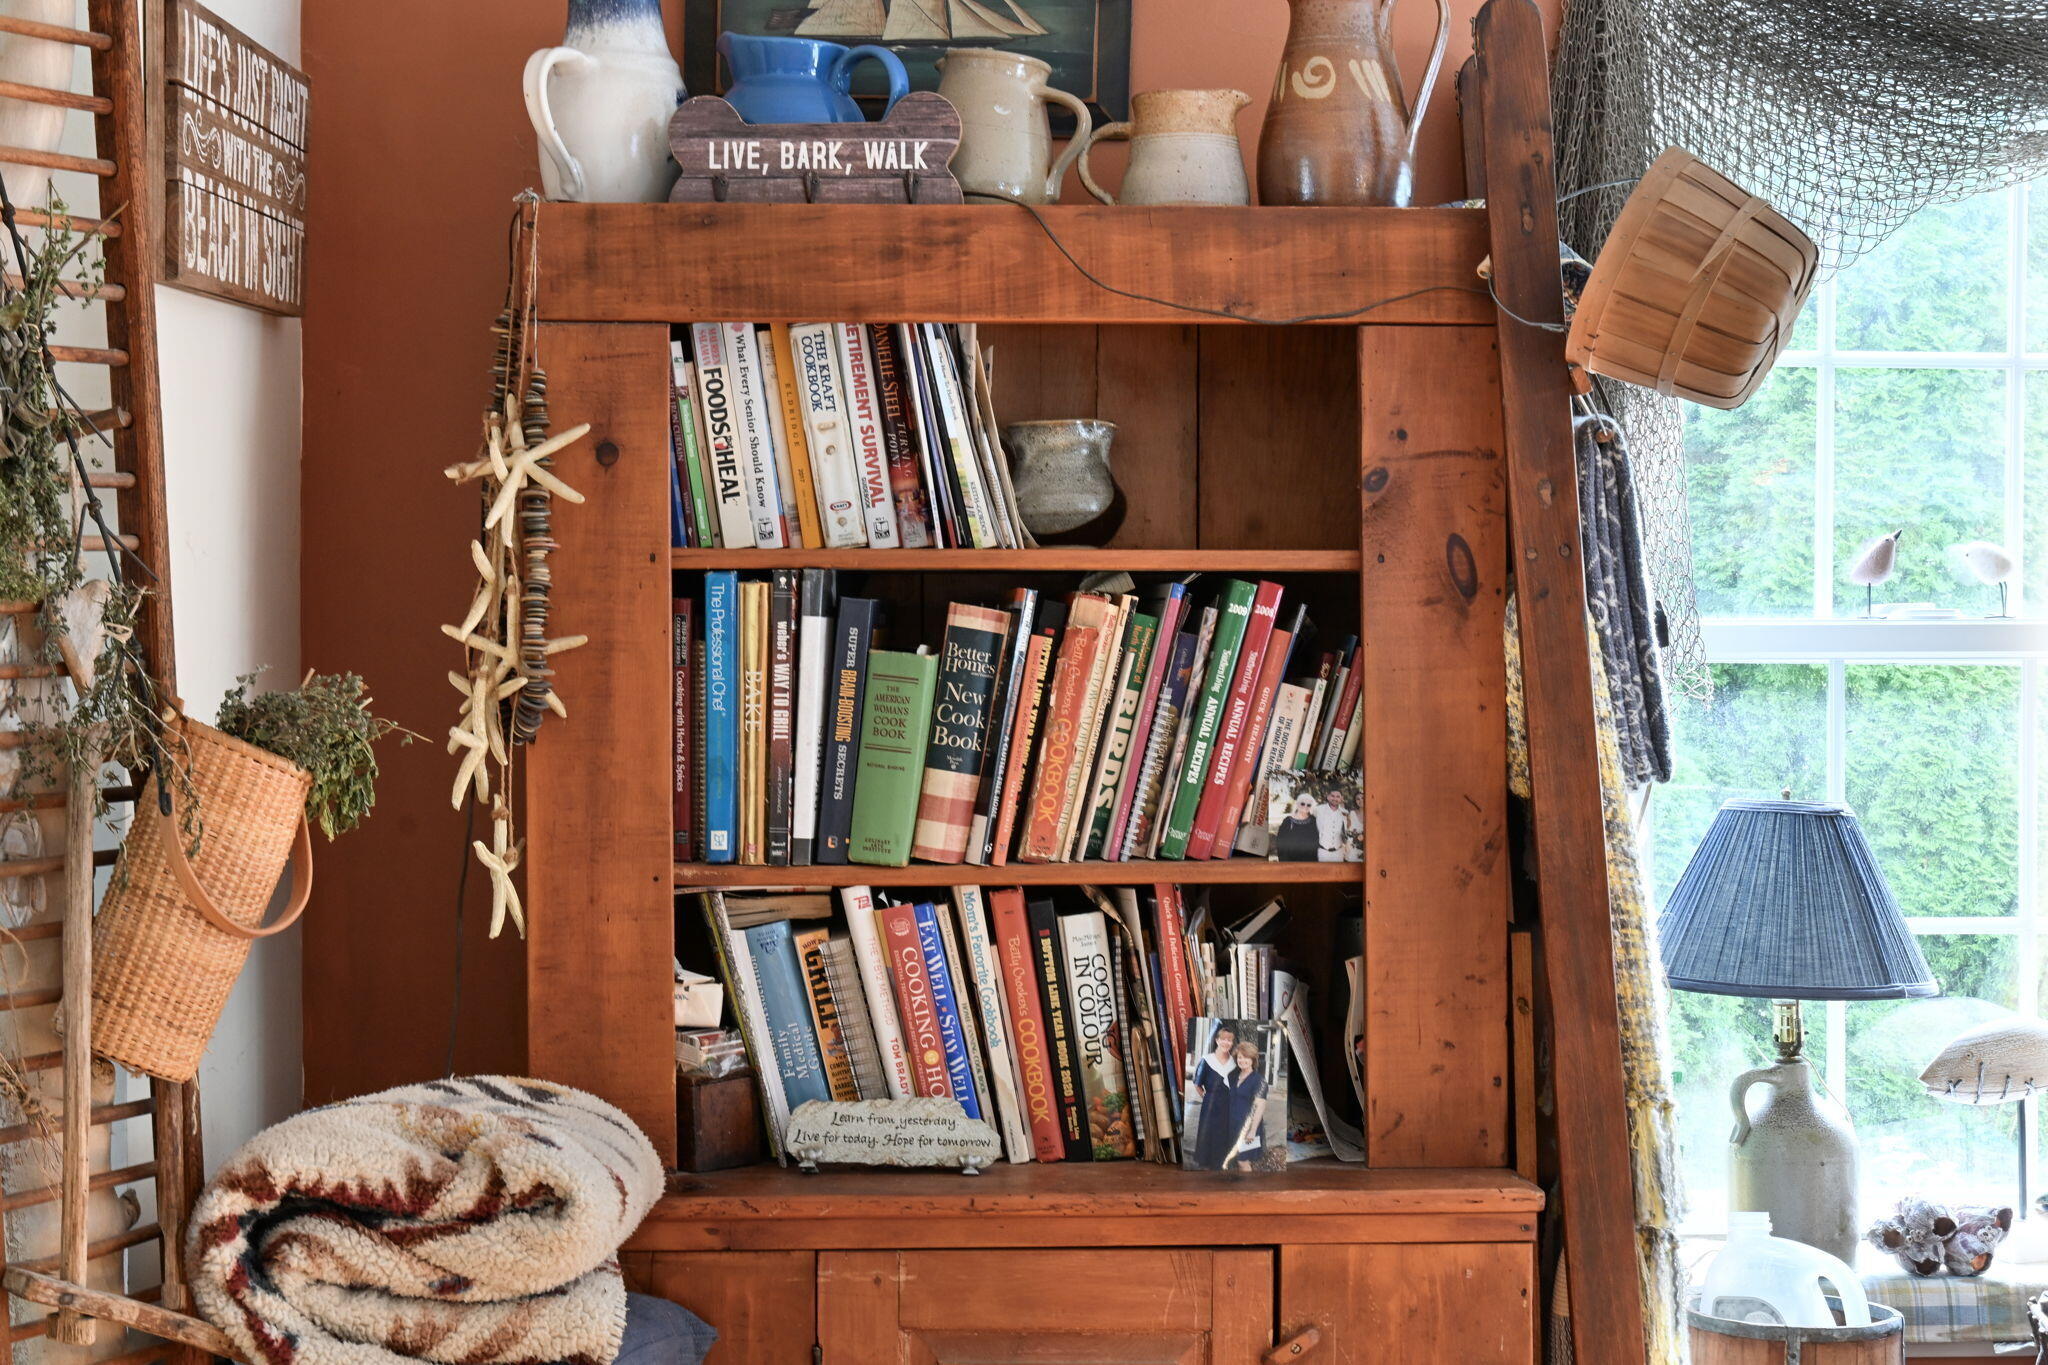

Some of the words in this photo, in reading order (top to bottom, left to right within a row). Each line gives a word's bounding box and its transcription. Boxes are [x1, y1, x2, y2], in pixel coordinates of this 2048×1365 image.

[182, 9, 231, 120] LIFE'S
[233, 43, 268, 139] JUST
[270, 65, 308, 162] RIGHT
[222, 129, 250, 188] WITH
[252, 147, 273, 197] THE
[708, 141, 769, 176] LIVE,
[780, 141, 852, 176] BARK,
[864, 141, 928, 170] WALK
[182, 167, 239, 285] BEACH
[243, 191, 258, 290] IN
[262, 204, 305, 306] SIGHT
[735, 333, 745, 363] What
[813, 330, 828, 361] THE
[739, 365, 750, 401] Every
[801, 336, 823, 413] COOKBOOK
[819, 362, 837, 413] KRAFT
[703, 367, 731, 437] FOODS
[744, 398, 756, 434] Senior
[785, 383, 801, 447] ELDRIDGE
[845, 322, 872, 421] ETIREMENT
[859, 425, 886, 508] SURVIVAL
[884, 380, 900, 419] STEEL
[672, 424, 684, 461] CURTAIN
[750, 435, 764, 475] Should
[887, 432, 902, 468] POINT
[897, 421, 910, 477] TURNING
[715, 448, 741, 504] HEAL
[755, 476, 766, 508] Know
[711, 583, 725, 608] The
[1228, 603, 1250, 616] 2009
[711, 609, 726, 680] Professional
[776, 620, 789, 660] weber's
[848, 626, 859, 668] SUPER
[947, 641, 992, 663] Better
[1074, 637, 1088, 669] Betty
[773, 663, 790, 688] WAY
[945, 657, 995, 674] Homes
[676, 670, 684, 707] Cooking
[712, 681, 726, 711] Chef
[744, 669, 763, 733] BAKE
[773, 690, 789, 706] TO
[834, 669, 857, 743] BRAIN-BOOSTING
[875, 694, 910, 705] AMERICAN
[886, 685, 900, 693] THE
[944, 681, 986, 706] New
[1061, 669, 1081, 717] Crocker's
[1256, 686, 1271, 714] QUICK
[676, 707, 684, 726] with
[772, 709, 789, 741] GRILL
[872, 727, 905, 740] BOOK
[873, 715, 906, 728] COOK
[937, 703, 985, 729] Cook
[1198, 695, 1219, 739] ANNUAL
[1225, 697, 1246, 740] ANNUAL
[1256, 714, 1262, 722] &
[1279, 716, 1285, 725] OF
[676, 727, 684, 754] Herbs
[933, 725, 982, 752] Book
[1099, 688, 1139, 809] BIRDS
[1158, 743, 1167, 758] For
[1243, 723, 1260, 763] HEALTHY
[1273, 726, 1281, 746] HOME
[1276, 732, 1290, 763] DOCTORS
[1325, 733, 1342, 768] Yorkshire
[676, 755, 684, 763] &
[833, 745, 847, 801] SECRETS
[1038, 717, 1071, 822] COOKBOOK
[1154, 757, 1164, 776] Life
[1185, 739, 1207, 785] RECIPES
[1213, 741, 1234, 786] RECIPES
[676, 764, 684, 792] Spices
[962, 891, 977, 932] Mom's
[1162, 896, 1172, 920] Quick
[918, 920, 937, 959] EAT
[1165, 920, 1175, 936] and
[971, 934, 990, 986] Favorite
[1008, 935, 1021, 968] Betty
[1039, 937, 1057, 982] BOTTOM
[1073, 956, 1092, 979] IN
[1168, 937, 1181, 971] Delicious
[927, 957, 947, 1009] WELL
[1011, 967, 1028, 1017] Crocker's
[1047, 983, 1061, 1008] LINE
[1173, 972, 1186, 1006] Gourmet
[877, 982, 894, 1026] METHOD
[979, 986, 1000, 1049] Cookbook
[1091, 953, 1116, 1050] COOKING
[901, 946, 937, 1050] COOKING
[925, 1066, 946, 1099] HO
[940, 1014, 959, 1057] STAY
[1051, 1010, 1065, 1038] YEAR
[1077, 983, 1103, 1069] COLOUR
[777, 1029, 795, 1079] Family
[787, 1022, 809, 1079] Medical
[804, 1025, 820, 1071] Guide
[888, 1037, 902, 1059] TOM
[972, 1055, 983, 1074] COOK
[1055, 1039, 1069, 1068] BOOK
[894, 1060, 911, 1096] BRADY
[976, 1074, 987, 1094] BOOK
[1018, 1019, 1050, 1124] COOKBOOK
[1060, 1069, 1073, 1096] 2020
[793, 1129, 820, 1144] Live
[822, 1131, 840, 1145] for
[842, 1134, 879, 1149] today.
[881, 1133, 915, 1148] Hope
[917, 1135, 934, 1149] for
[937, 1137, 995, 1148] tomorrow.
[830, 1111, 864, 1127] Learn
[867, 1112, 896, 1125] from
[899, 1114, 960, 1132] yesterday.
